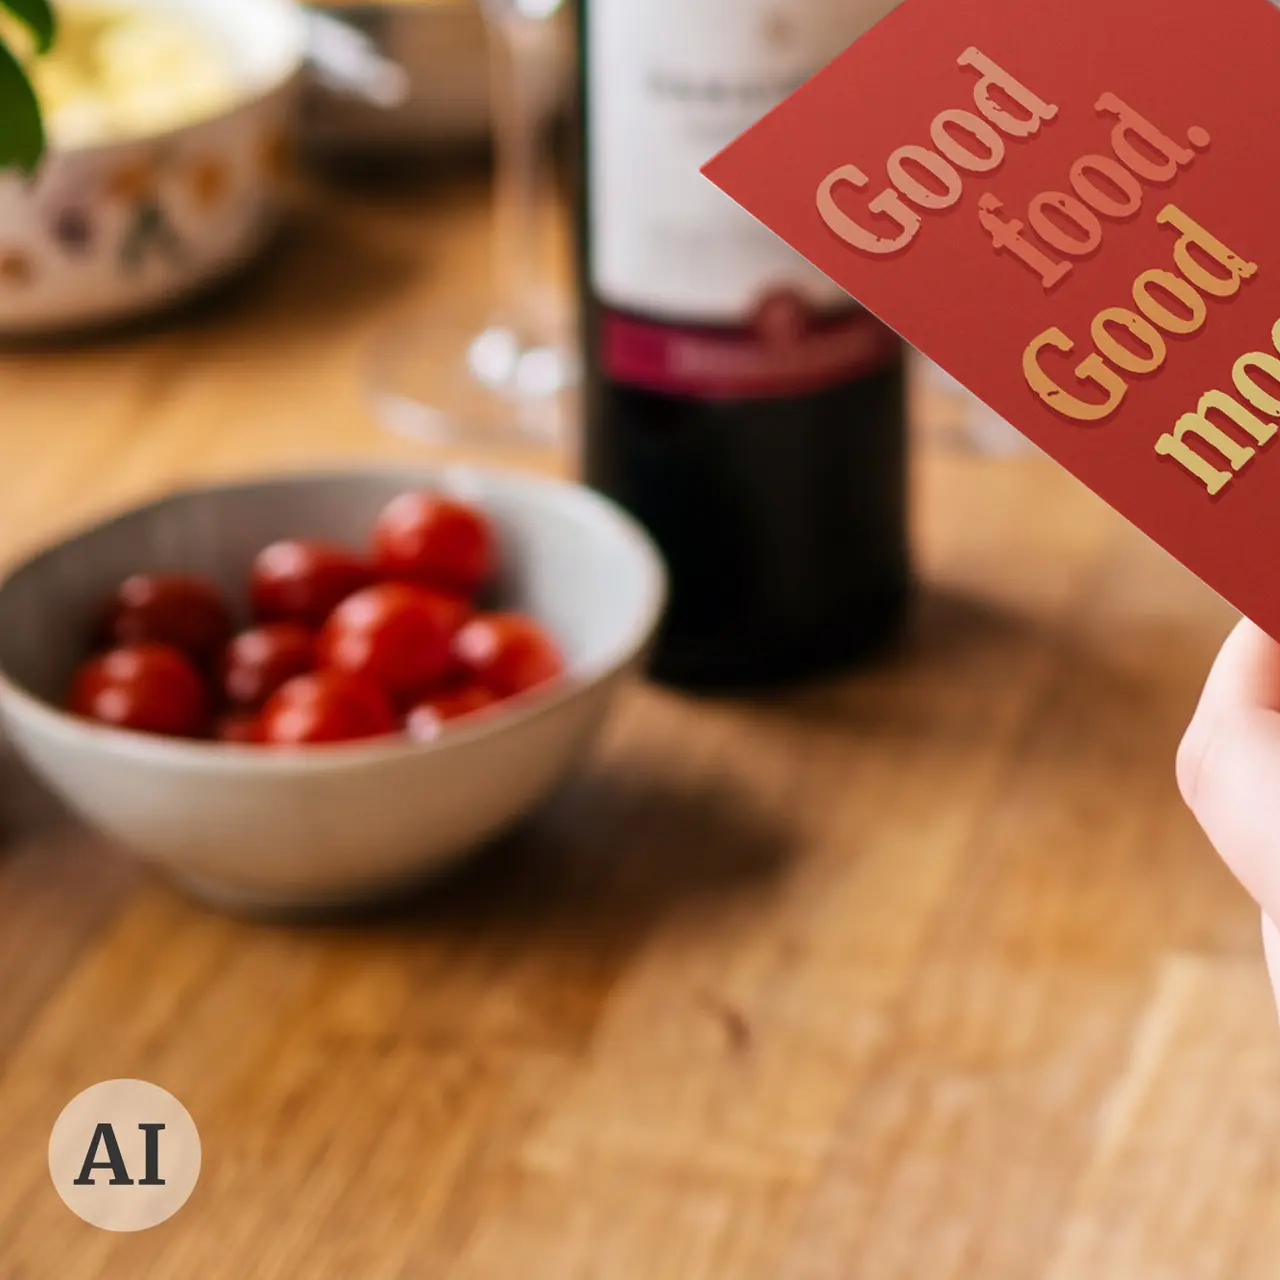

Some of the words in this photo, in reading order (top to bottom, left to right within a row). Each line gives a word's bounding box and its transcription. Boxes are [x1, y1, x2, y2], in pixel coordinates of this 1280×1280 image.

[815, 46, 1059, 254] Good
[977, 92, 1211, 288] food.
[1022, 204, 1258, 421] Good
